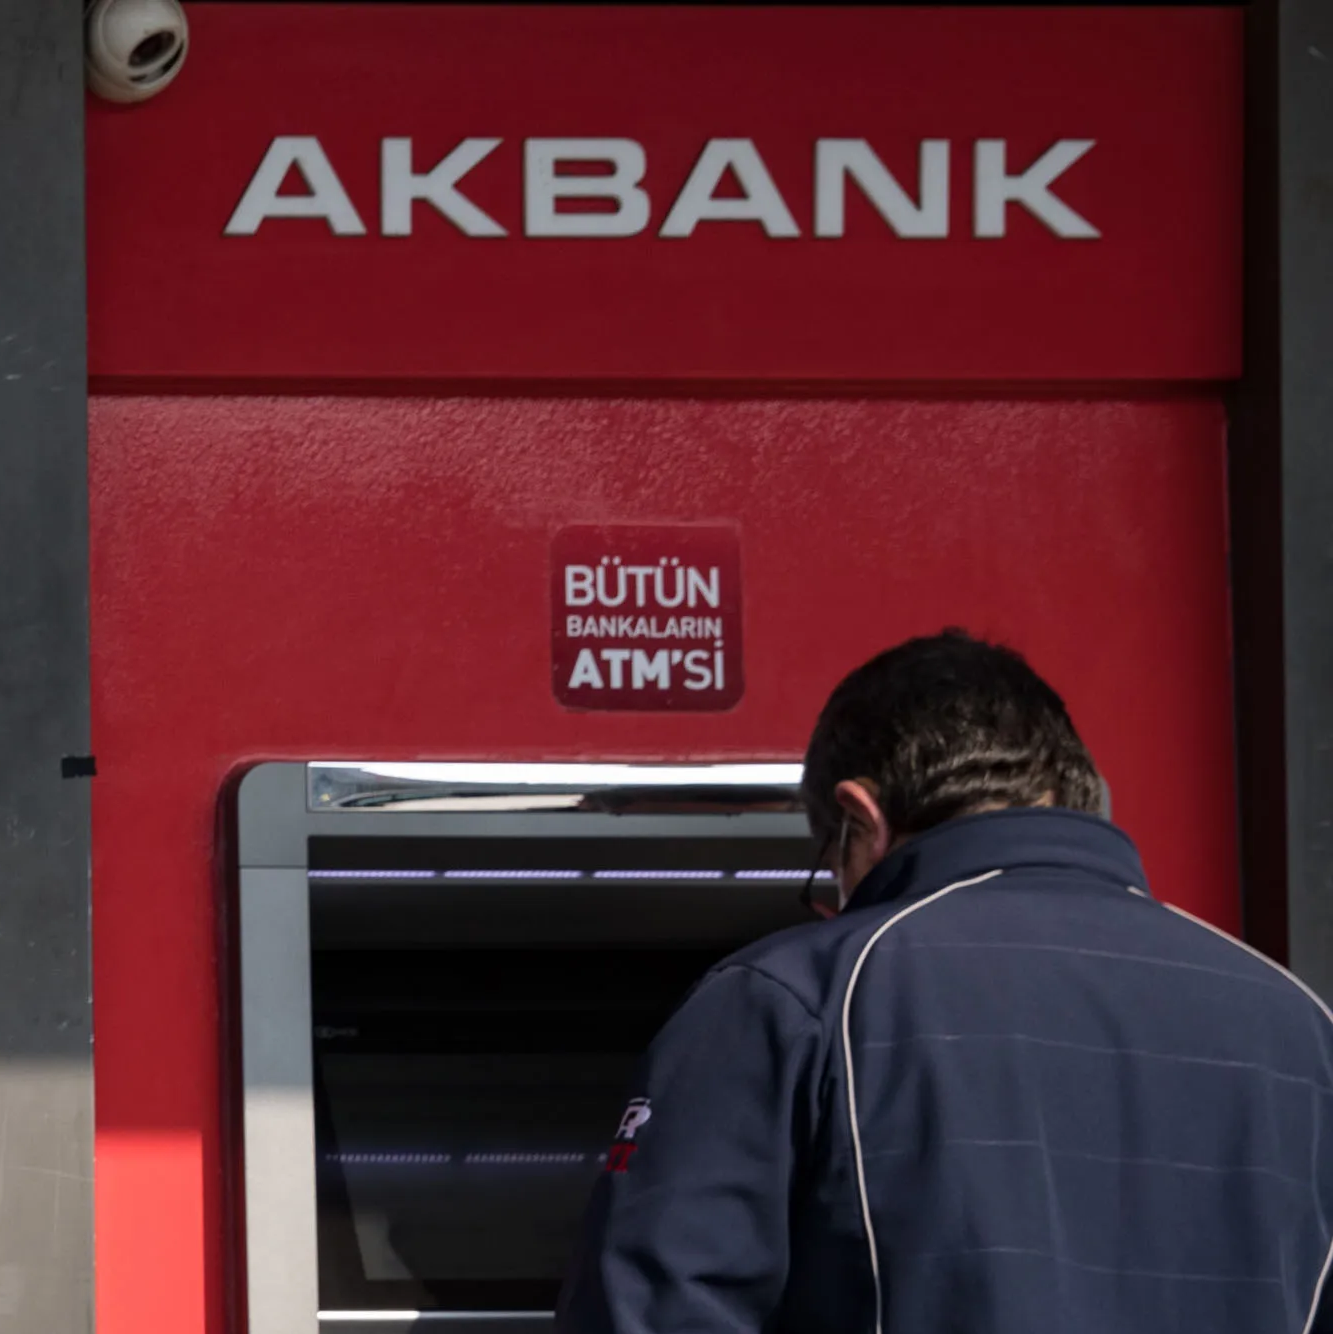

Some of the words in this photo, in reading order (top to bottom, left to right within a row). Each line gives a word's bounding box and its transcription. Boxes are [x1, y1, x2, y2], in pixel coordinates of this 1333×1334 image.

[221, 135, 1102, 238] AKBANK
[564, 555, 721, 608] BÜTÜN
[566, 614, 723, 639] BANKALARIN
[568, 639, 725, 691] ATM'Sİ
